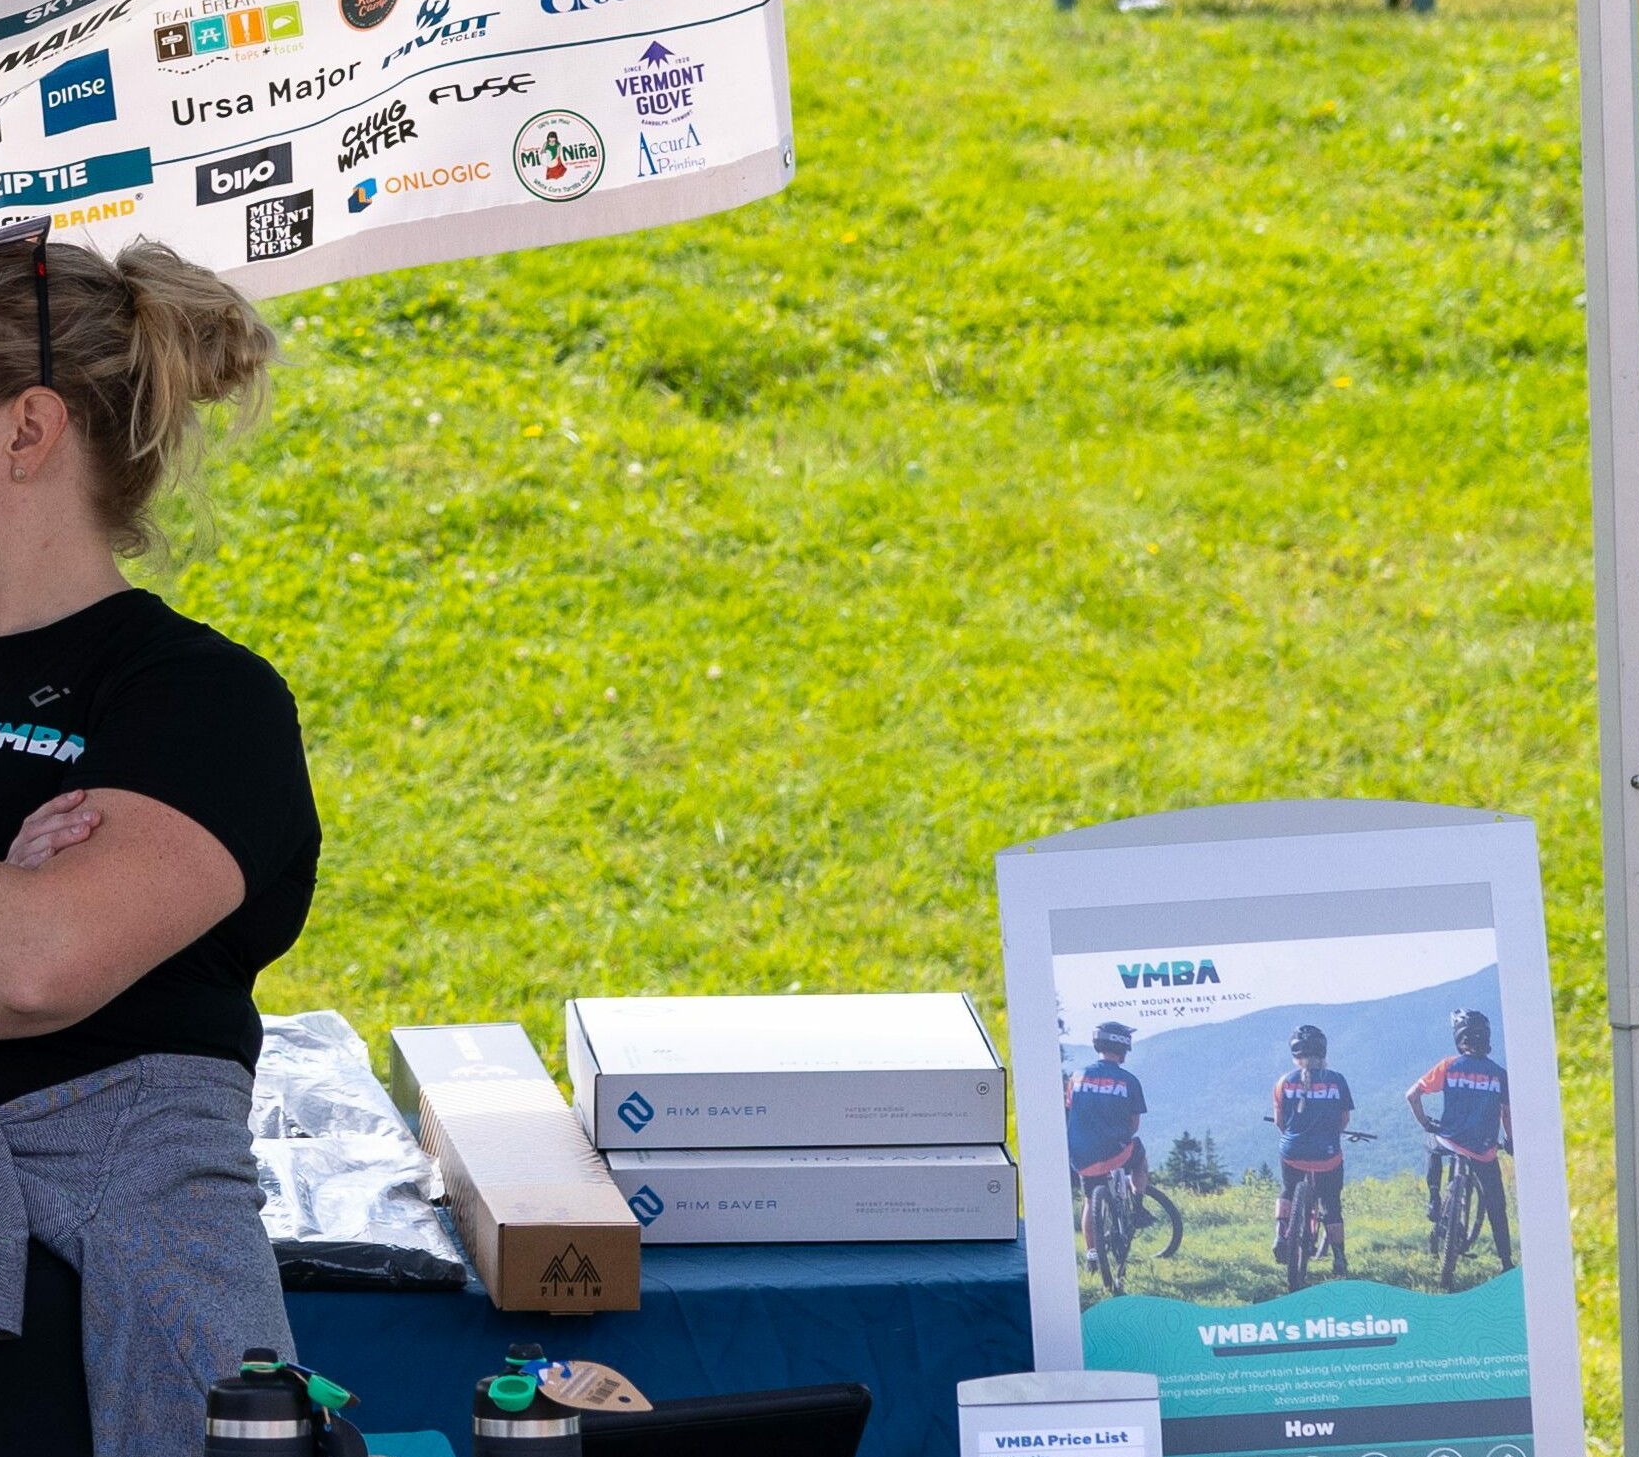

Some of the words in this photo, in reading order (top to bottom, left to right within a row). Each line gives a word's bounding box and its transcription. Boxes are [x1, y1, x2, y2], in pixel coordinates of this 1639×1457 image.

[153, 5, 200, 24] TRAIL
[382, 12, 501, 70] PIVOT
[441, 29, 486, 46] CYCLES
[171, 93, 255, 126] Ursa
[268, 61, 362, 106] Major
[615, 63, 705, 98] VERMONT
[636, 88, 694, 116] GLOVE
[342, 99, 407, 147] CHUG
[337, 118, 418, 173] WATER
[521, 151, 541, 167] Mi
[562, 143, 598, 161] Niña
[40, 162, 88, 192] TIE
[385, 162, 491, 194] ONLOGIC
[53, 199, 135, 229] BRAND
[250, 199, 285, 220] MIS
[251, 205, 312, 232] SPENT
[250, 226, 291, 244] SUM
[250, 233, 302, 258] MERS
[1116, 958, 1220, 989] VMBA
[1092, 999, 1138, 1011] VERMONT
[1141, 996, 1192, 1006] MOUNTAIN
[1196, 994, 1216, 1004] BIKE
[1139, 1008, 1168, 1017] SINCE
[1189, 1006, 1210, 1015] 1997
[666, 1106, 700, 1116] RIM
[708, 1106, 768, 1116] SAVER
[676, 1200, 710, 1211] RIM
[717, 1199, 778, 1210] SAVER
[1197, 1320, 1301, 1346] VMBA's
[1305, 1315, 1409, 1339] Mission
[1228, 1370, 1239, 1379] of
[1241, 1366, 1293, 1378] mountain
[1295, 1362, 1329, 1377] biking
[1330, 1364, 1342, 1373] in
[1343, 1360, 1391, 1373] Vermont
[1392, 1358, 1414, 1370] and
[1416, 1353, 1482, 1370] thoughtfully
[1183, 1383, 1247, 1397] experiences
[1248, 1380, 1293, 1395] through
[1405, 1373, 1427, 1383] and
[1428, 1368, 1528, 1383] community-driven
[995, 1435, 1045, 1449] VMBA
[1047, 1434, 1092, 1446] Price
[1095, 1432, 1129, 1444] List
[1285, 1419, 1335, 1438] How
